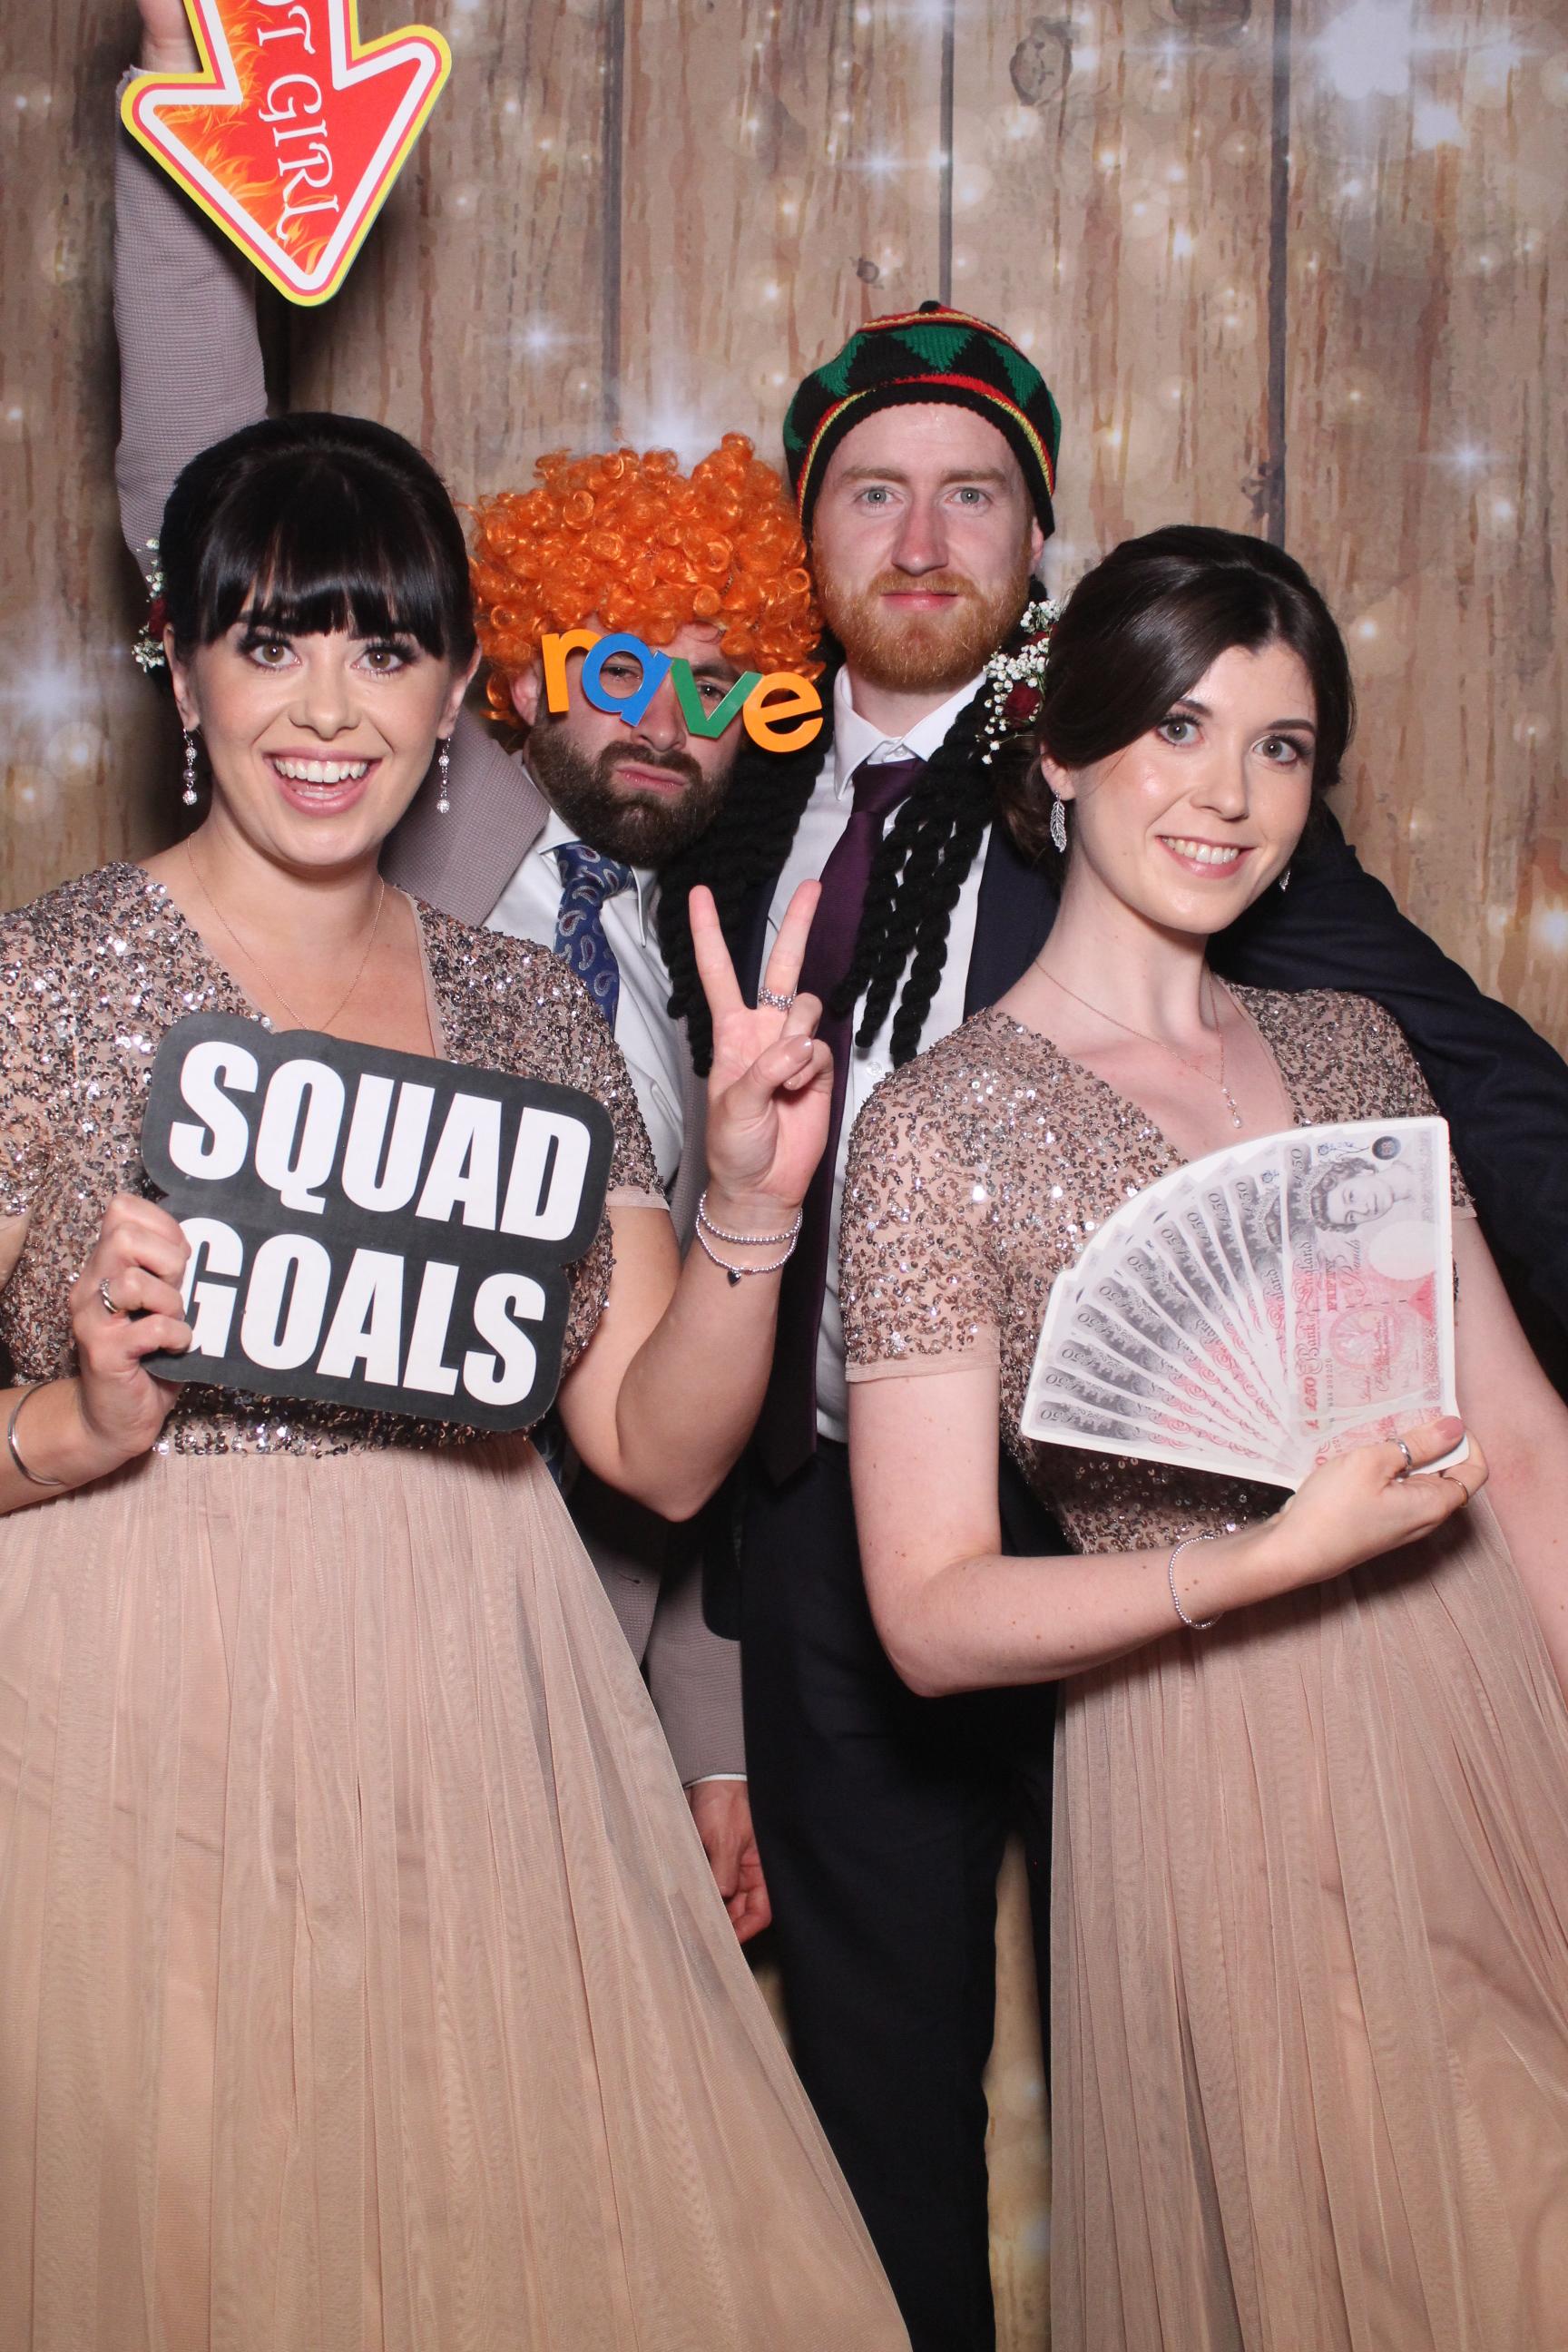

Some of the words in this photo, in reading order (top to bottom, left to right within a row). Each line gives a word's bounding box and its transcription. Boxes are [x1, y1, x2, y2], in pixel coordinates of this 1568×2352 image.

[259, 74, 340, 240] GIRL
[542, 629, 824, 753] rave
[169, 1041, 592, 1242] SQUAD
[181, 1217, 546, 1406] GOALS
